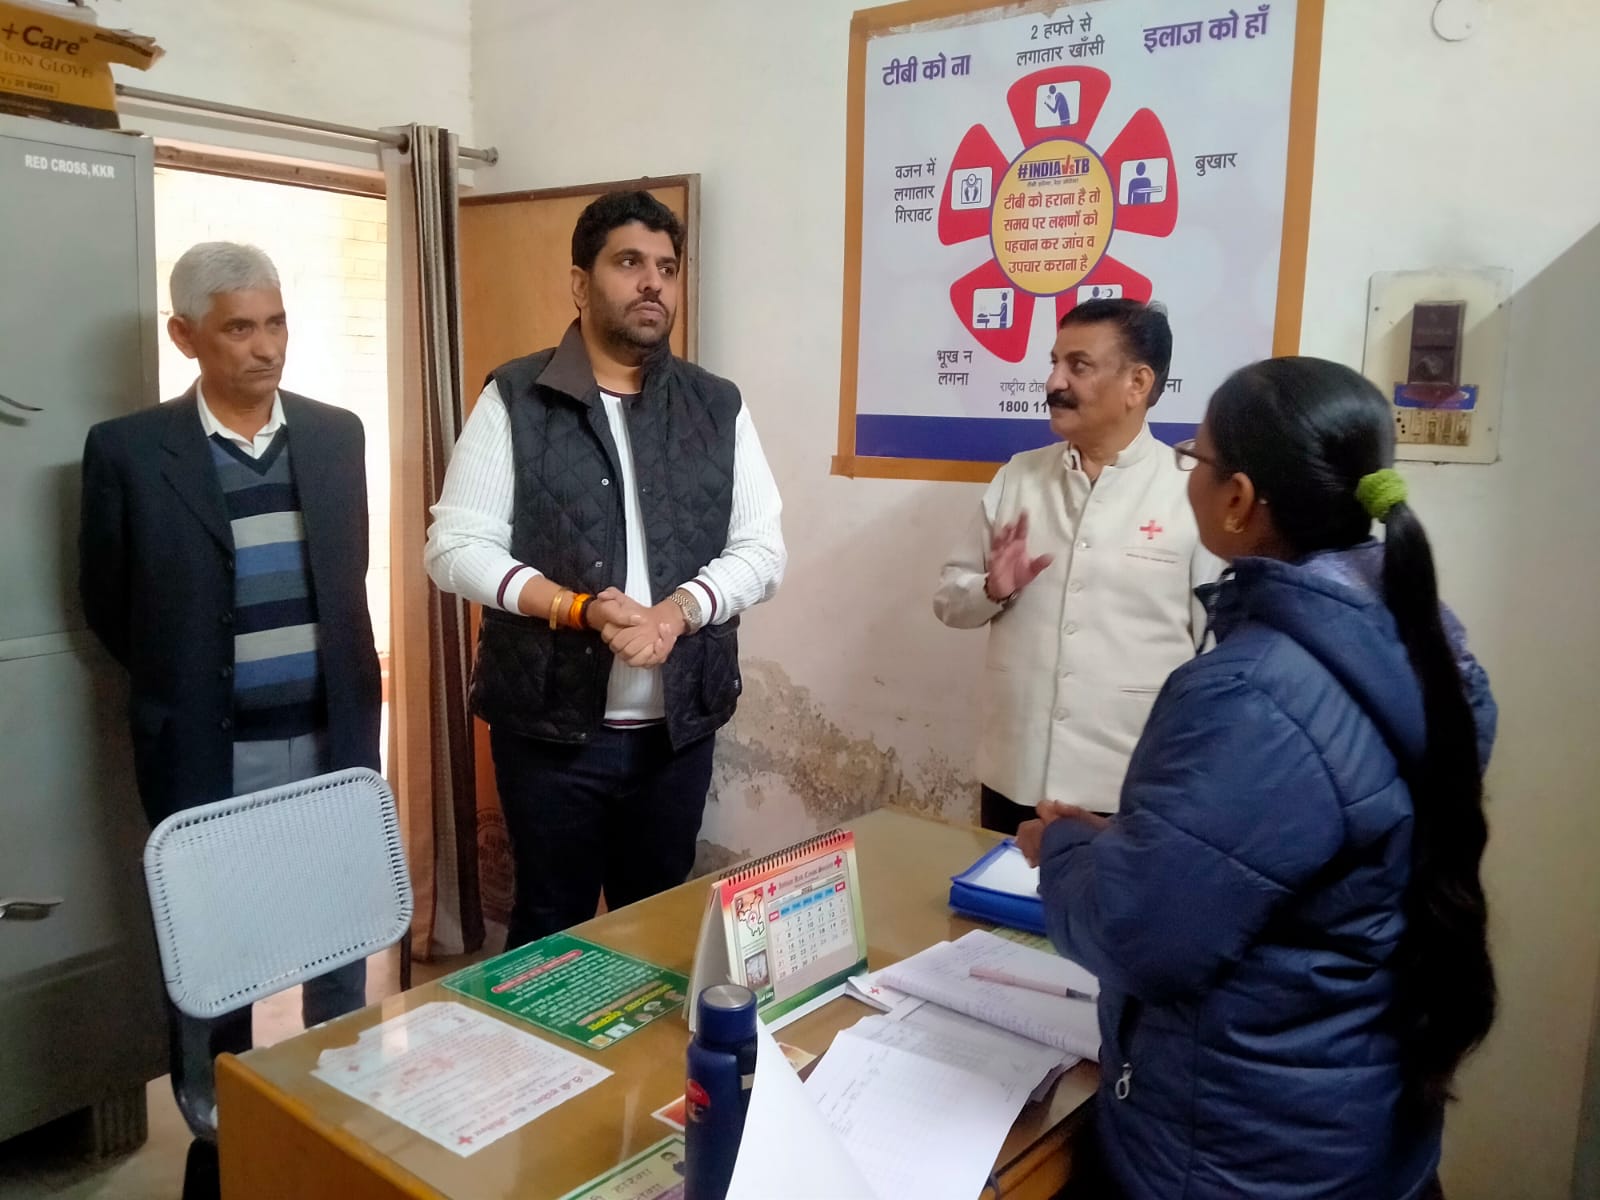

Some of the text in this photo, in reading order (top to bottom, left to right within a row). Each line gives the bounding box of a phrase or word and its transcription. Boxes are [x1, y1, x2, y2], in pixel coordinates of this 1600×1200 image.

[1030, 12, 1092, 40] 2 हफ्ते से
[1143, 4, 1270, 53] इलाज को हाँ
[0, 51, 33, 67] ION
[1016, 34, 1106, 66] लगातार खाँसी
[882, 51, 971, 86] टीबी को ना
[25, 154, 48, 170] RED
[92, 164, 115, 179] KKR
[895, 157, 937, 179] वजन में
[1195, 152, 1238, 176] बुखार
[894, 185, 935, 201] लगातार
[1004, 187, 1101, 210] टीबी को हराना है तो
[894, 204, 933, 223] गिरावट
[1004, 209, 1098, 231] समय पर लक्षणों को
[1005, 232, 1095, 253] पहचान कर जांच व
[1008, 253, 1088, 274] उपचार कराना है
[937, 350, 973, 369] भूख न
[938, 372, 969, 385] लगना
[1000, 378, 1046, 397] राष्ट्रीय टोल
[1165, 378, 1183, 393] ना
[999, 401, 1047, 413] 1800 11
